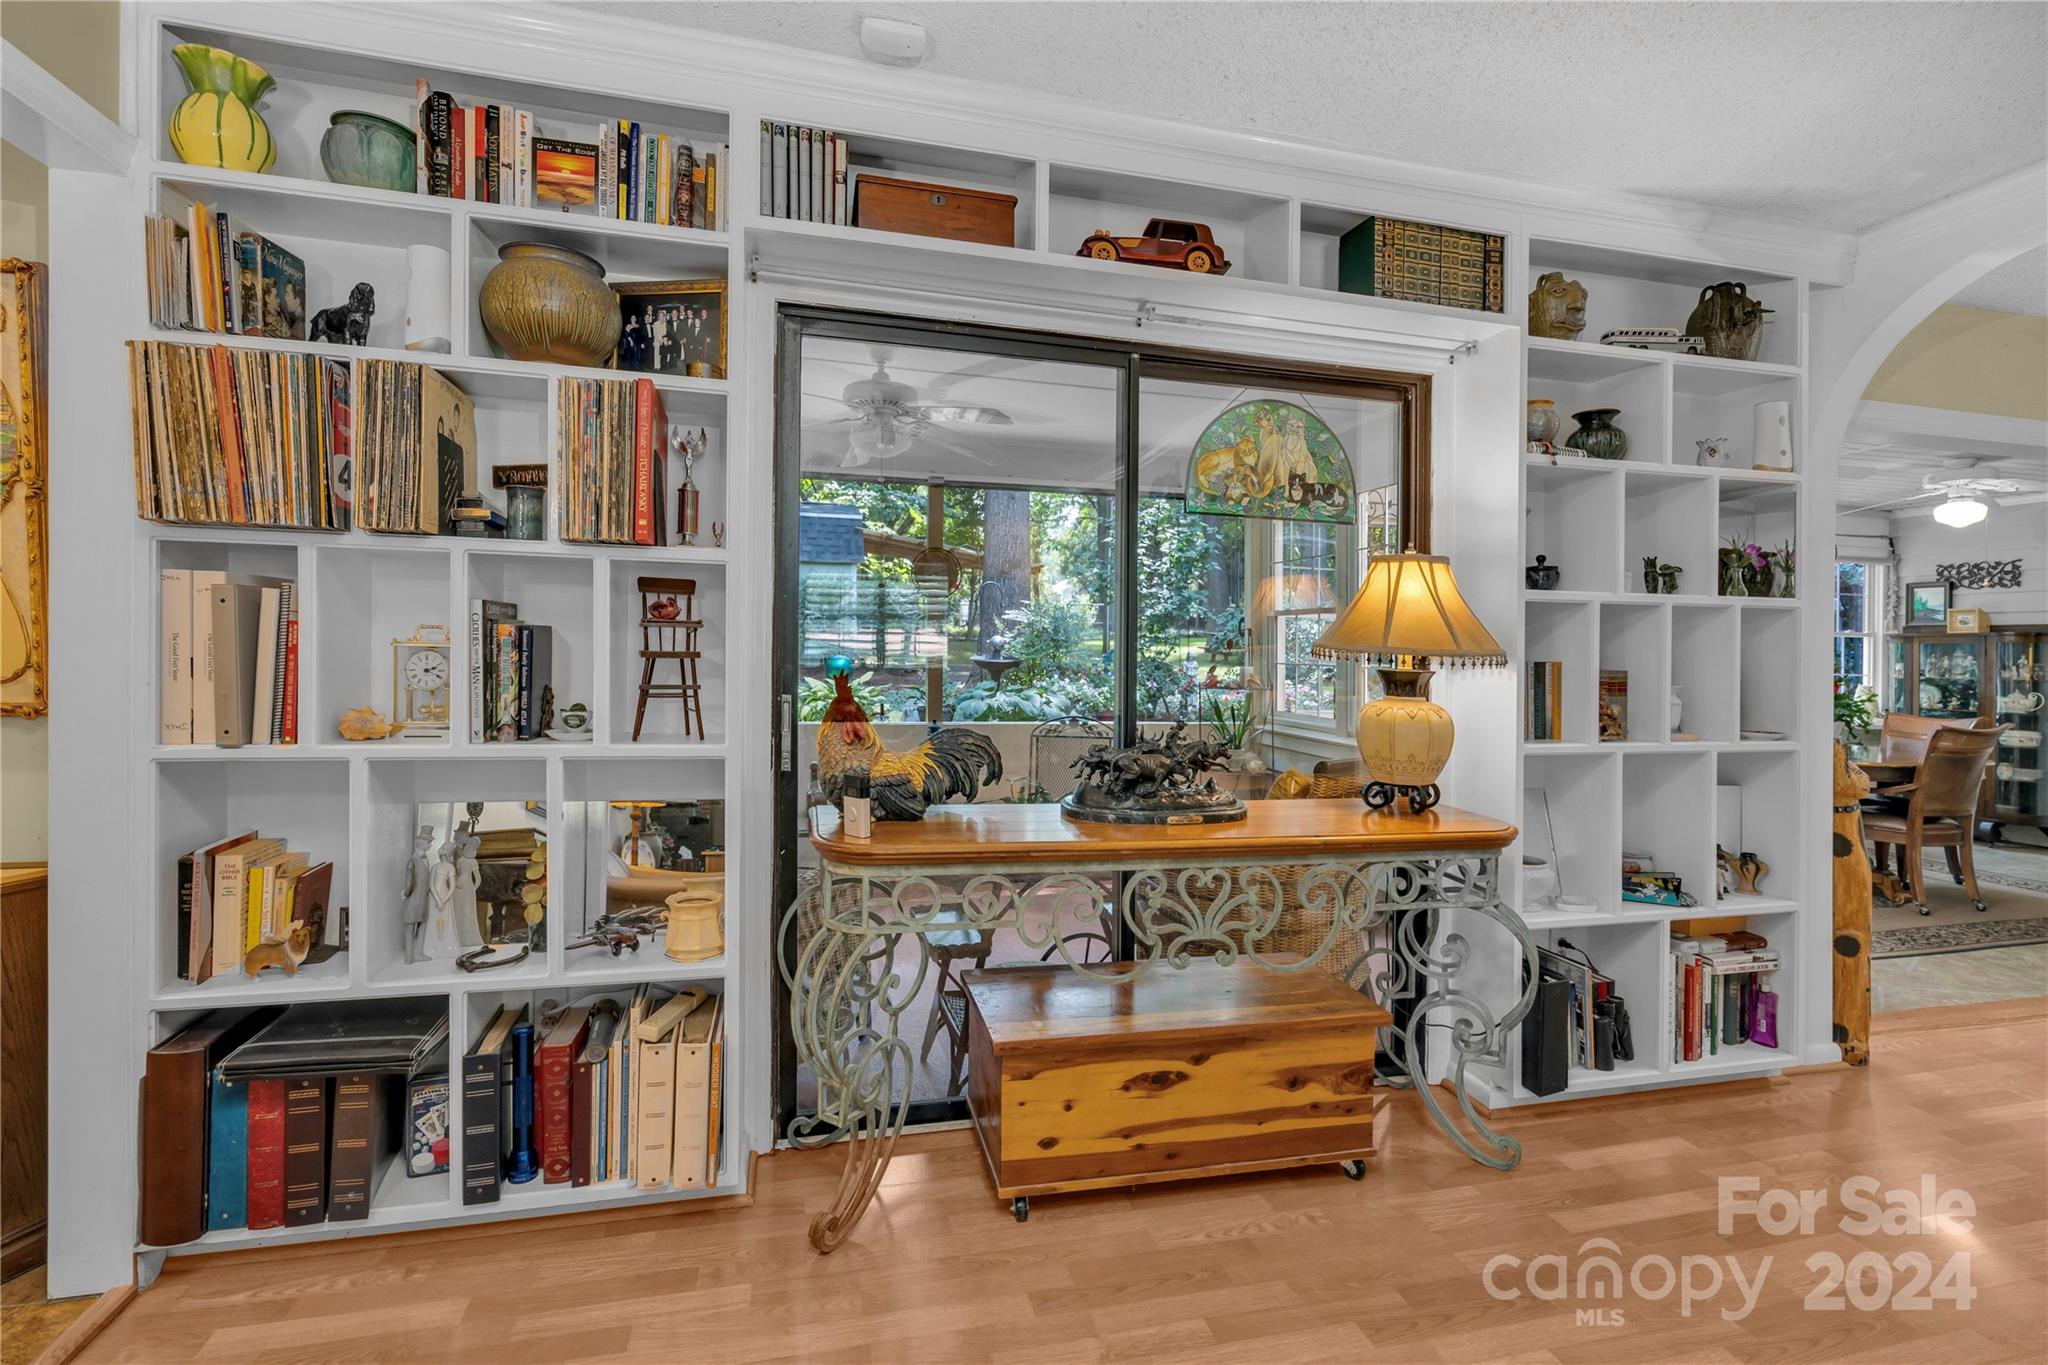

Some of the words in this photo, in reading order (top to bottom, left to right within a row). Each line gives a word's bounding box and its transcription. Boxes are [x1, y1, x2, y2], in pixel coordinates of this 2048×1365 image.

[439, 99, 448, 139] BEYOND
[639, 457, 648, 513] TCHAIKOVSKY
[471, 612, 481, 648] CLOTHES
[471, 665, 481, 685] MAN
